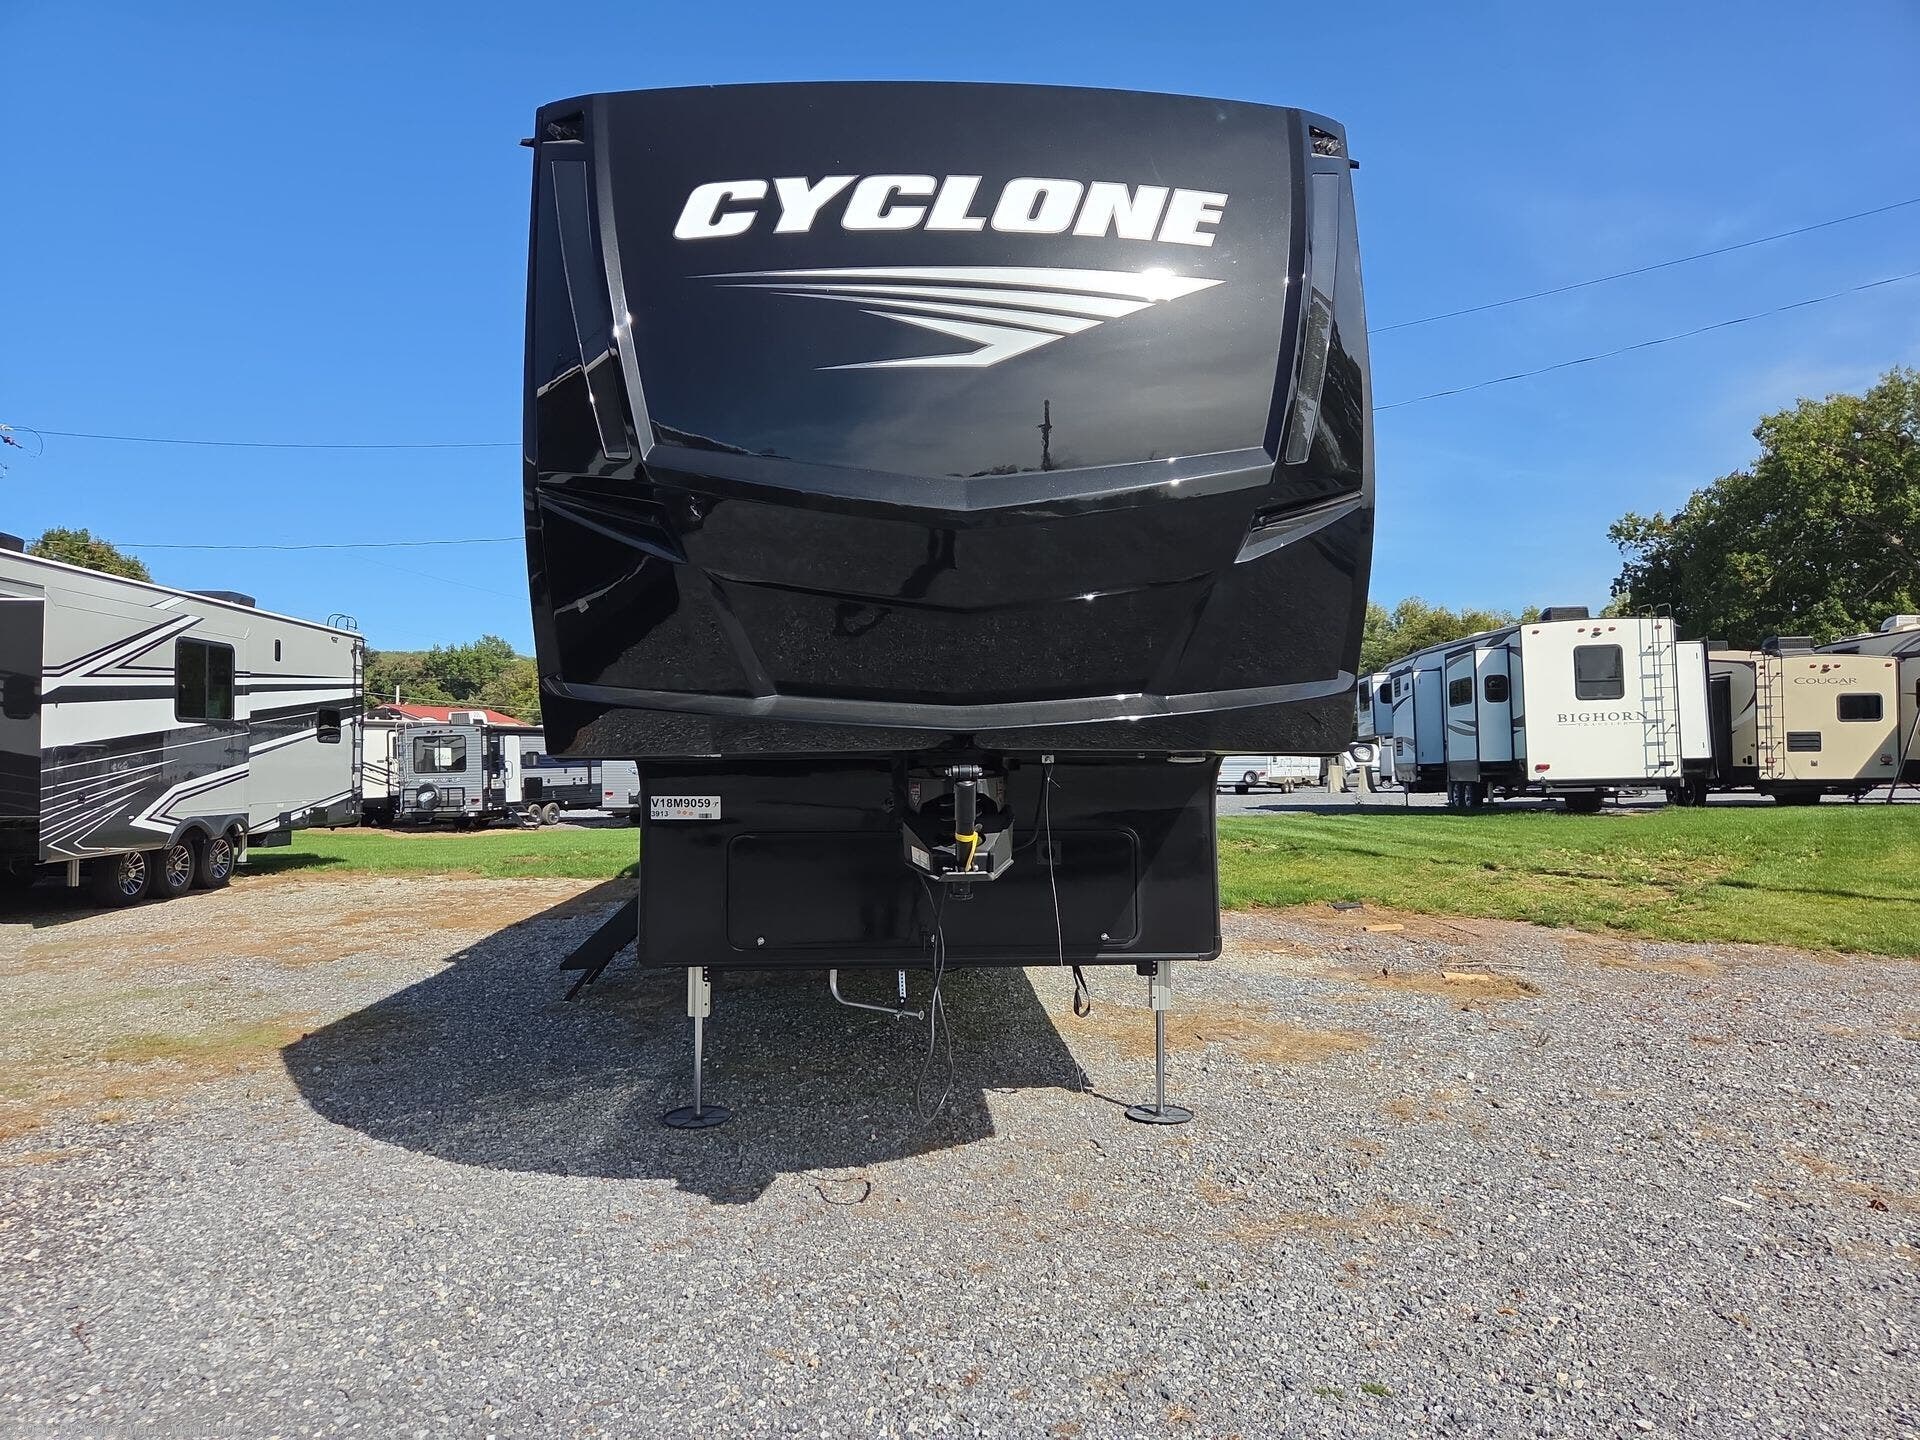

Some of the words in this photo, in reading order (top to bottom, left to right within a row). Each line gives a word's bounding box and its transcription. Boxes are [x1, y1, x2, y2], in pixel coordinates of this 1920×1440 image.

[671, 173, 1229, 248] CYCLONE
[1793, 677, 1857, 685] COUGAR
[1557, 711, 1648, 723] BIGHORN
[651, 798, 711, 808] V18M9059
